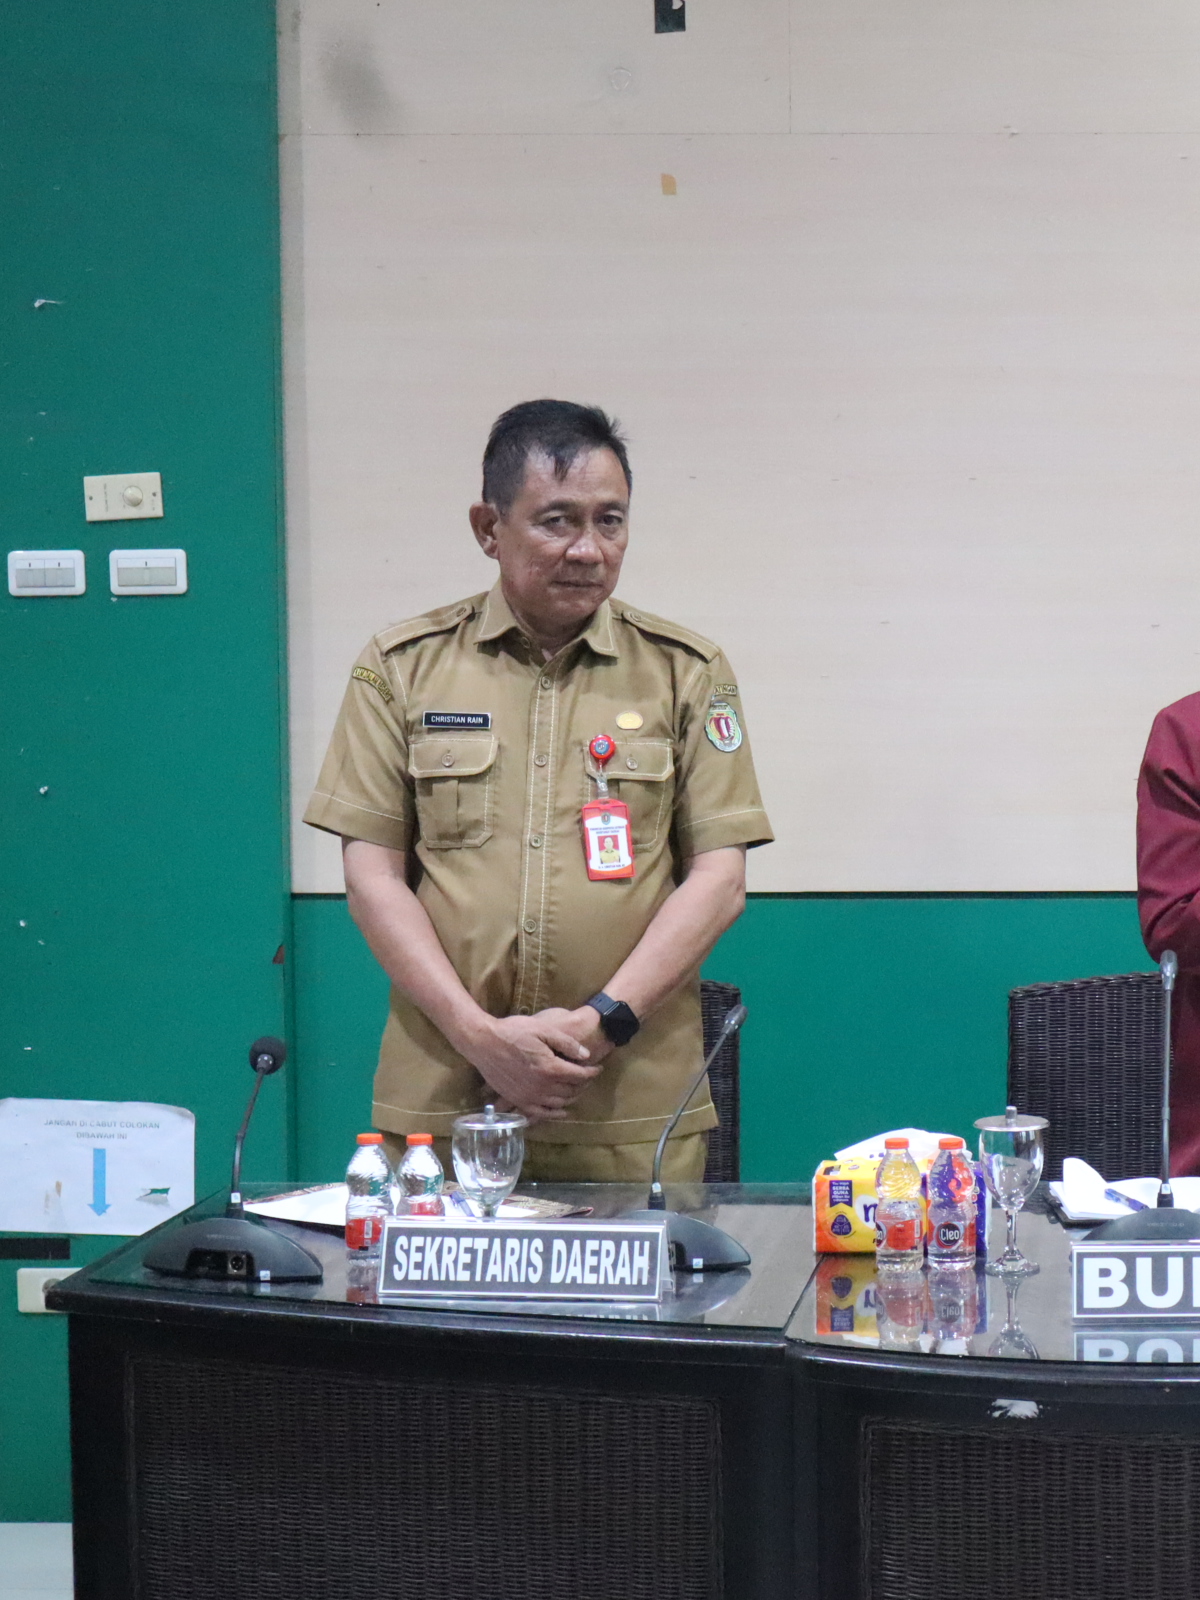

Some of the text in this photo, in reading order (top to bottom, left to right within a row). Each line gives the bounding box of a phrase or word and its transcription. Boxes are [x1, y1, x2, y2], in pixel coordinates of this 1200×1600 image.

[431, 715, 483, 724] CHRISTIAN RAIN
[44, 1119, 77, 1127] JANGAN
[90, 1120, 117, 1128] CABUT
[119, 1121, 160, 1129] COLOKAN
[940, 1229, 959, 1240] Cleo
[392, 1235, 650, 1286] SEKRETARIS DAERAH
